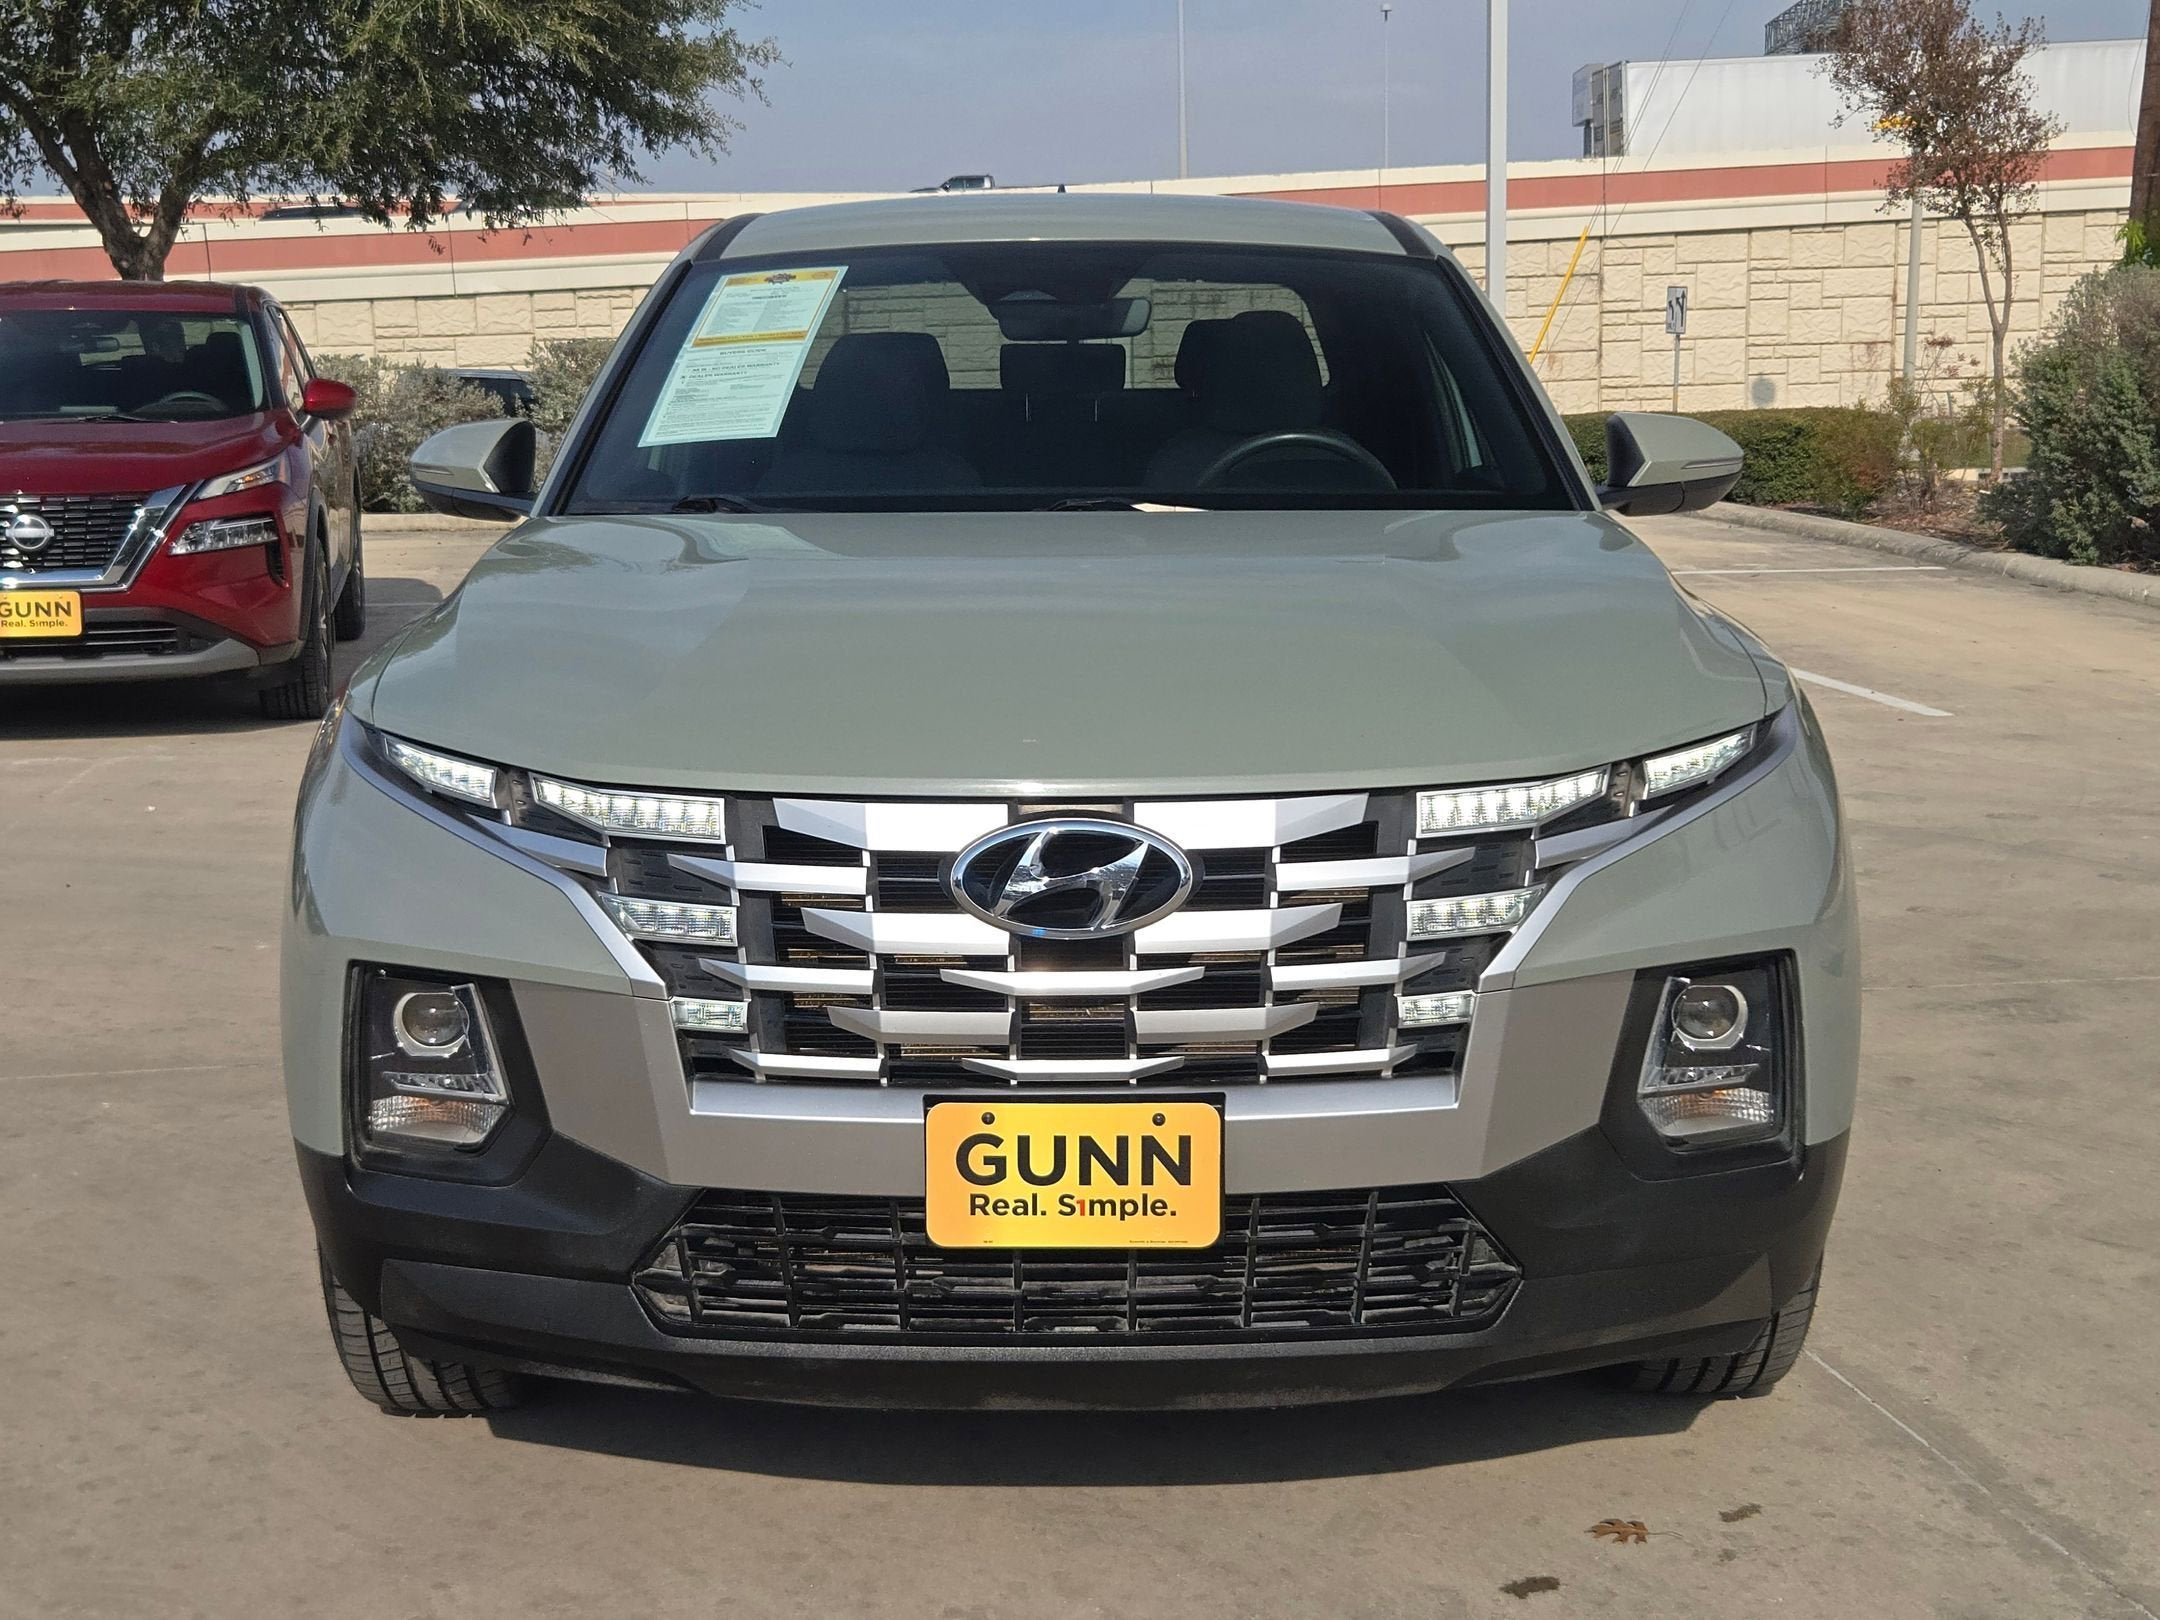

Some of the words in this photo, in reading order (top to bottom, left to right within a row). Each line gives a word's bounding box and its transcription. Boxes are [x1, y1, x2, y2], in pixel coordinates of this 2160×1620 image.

[0, 601, 72, 618] GUNN
[1, 619, 27, 628] Real.
[955, 1132, 1192, 1187] GUNN
[969, 1193, 1047, 1217] Real.
